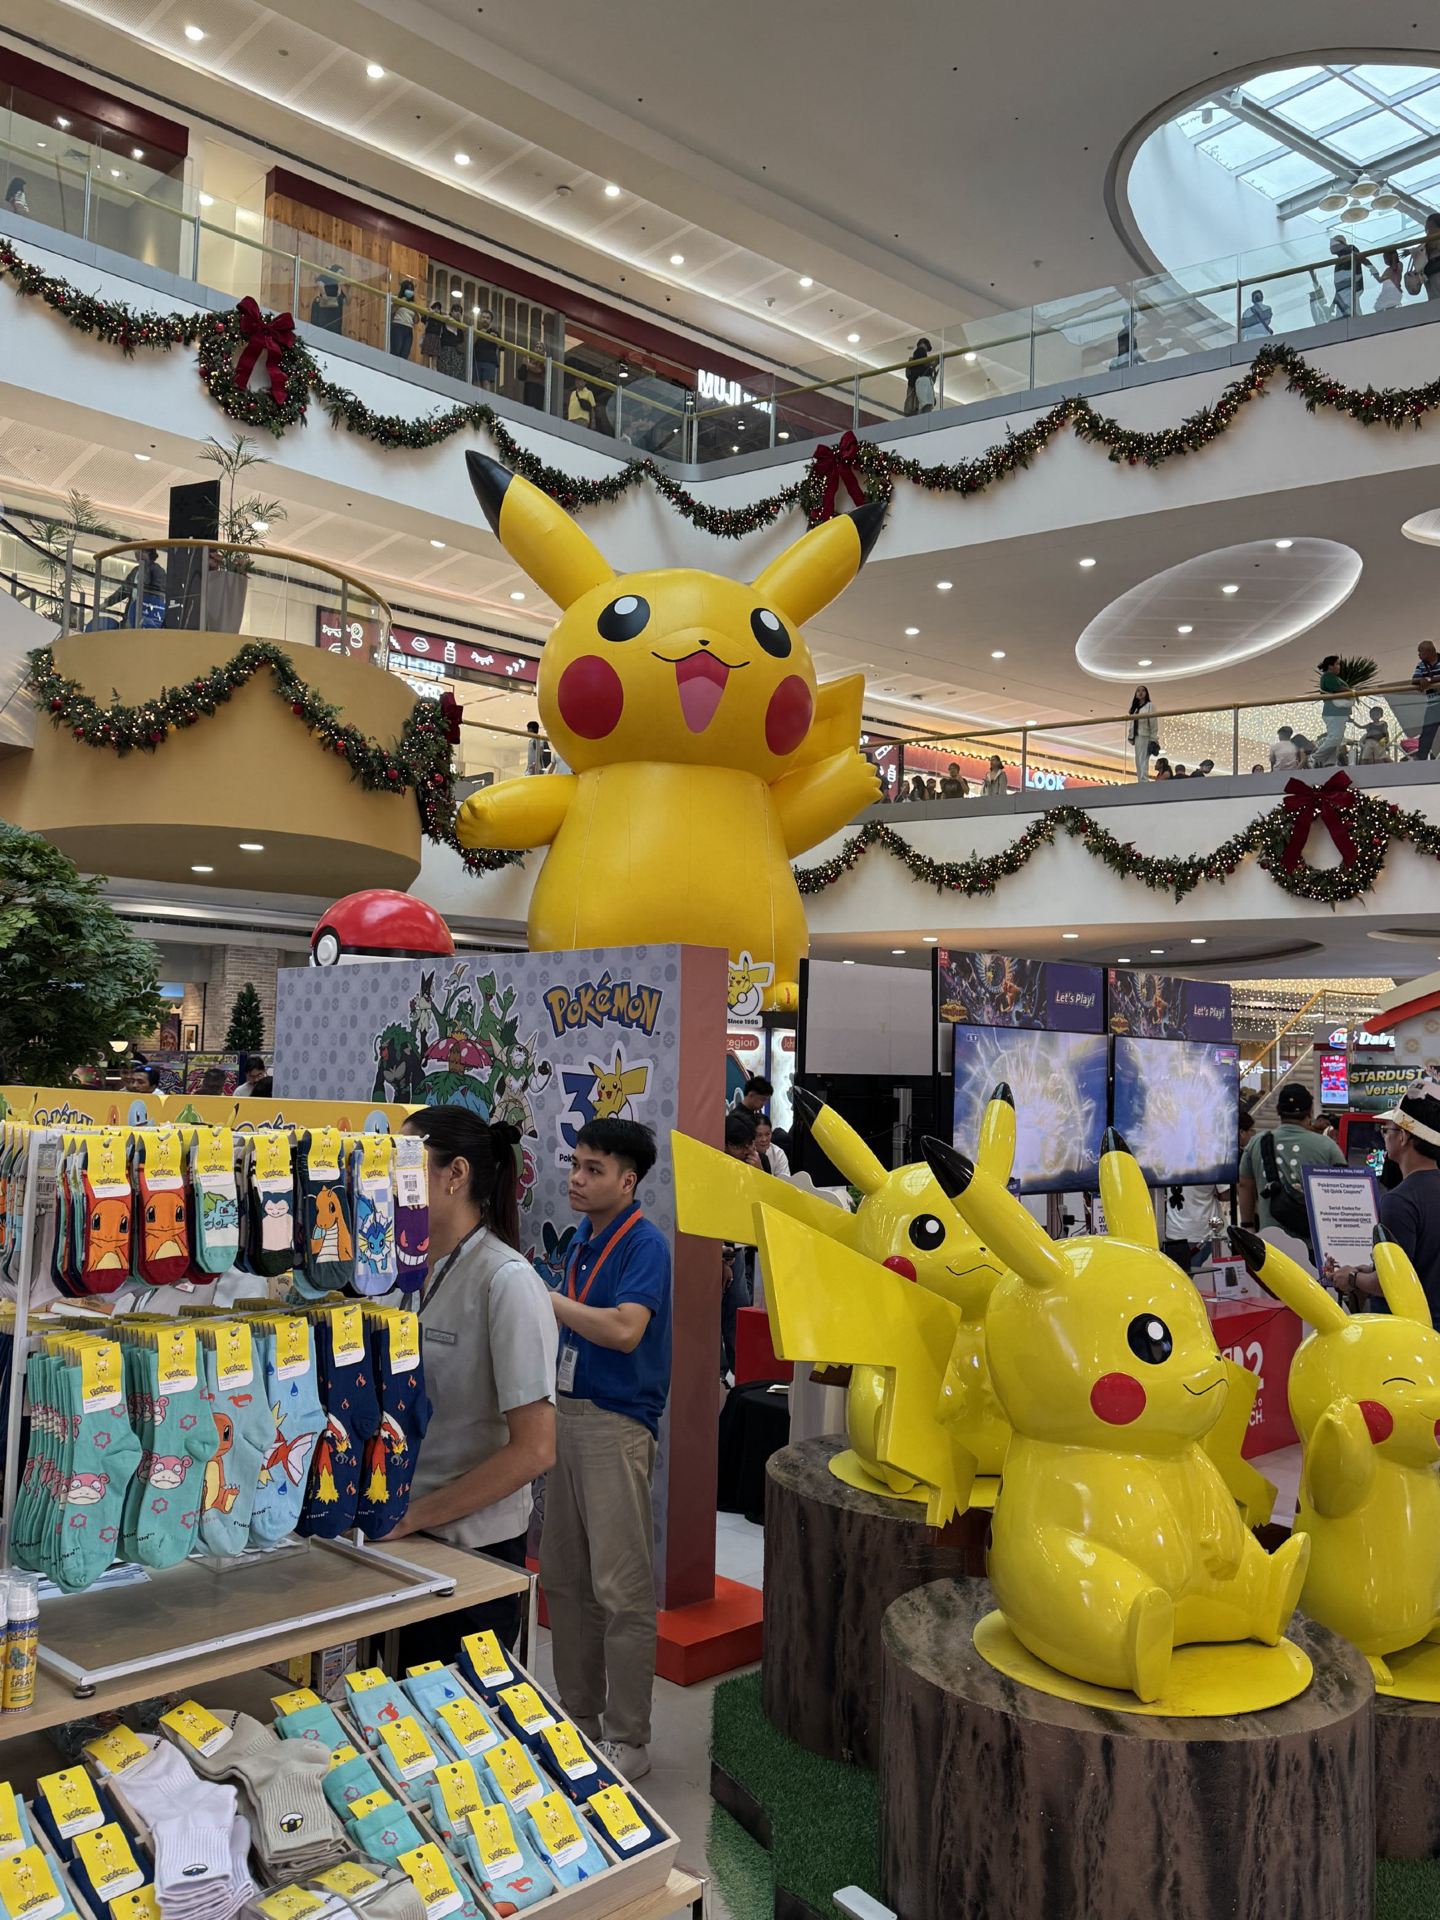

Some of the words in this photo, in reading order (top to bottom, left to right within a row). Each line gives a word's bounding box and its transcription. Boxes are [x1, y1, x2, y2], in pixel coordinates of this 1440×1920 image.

[698, 368, 741, 406] MUJI
[1025, 767, 1066, 790] LOOK
[1055, 991, 1074, 1004] Let's
[1075, 992, 1095, 1008] Play!
[1193, 1004, 1208, 1017] Let's
[1209, 1007, 1226, 1019] Play!
[1350, 1068, 1425, 1084] STARDUST
[1365, 1083, 1410, 1096] Versio
[12, 1671, 33, 1682] FOOT
